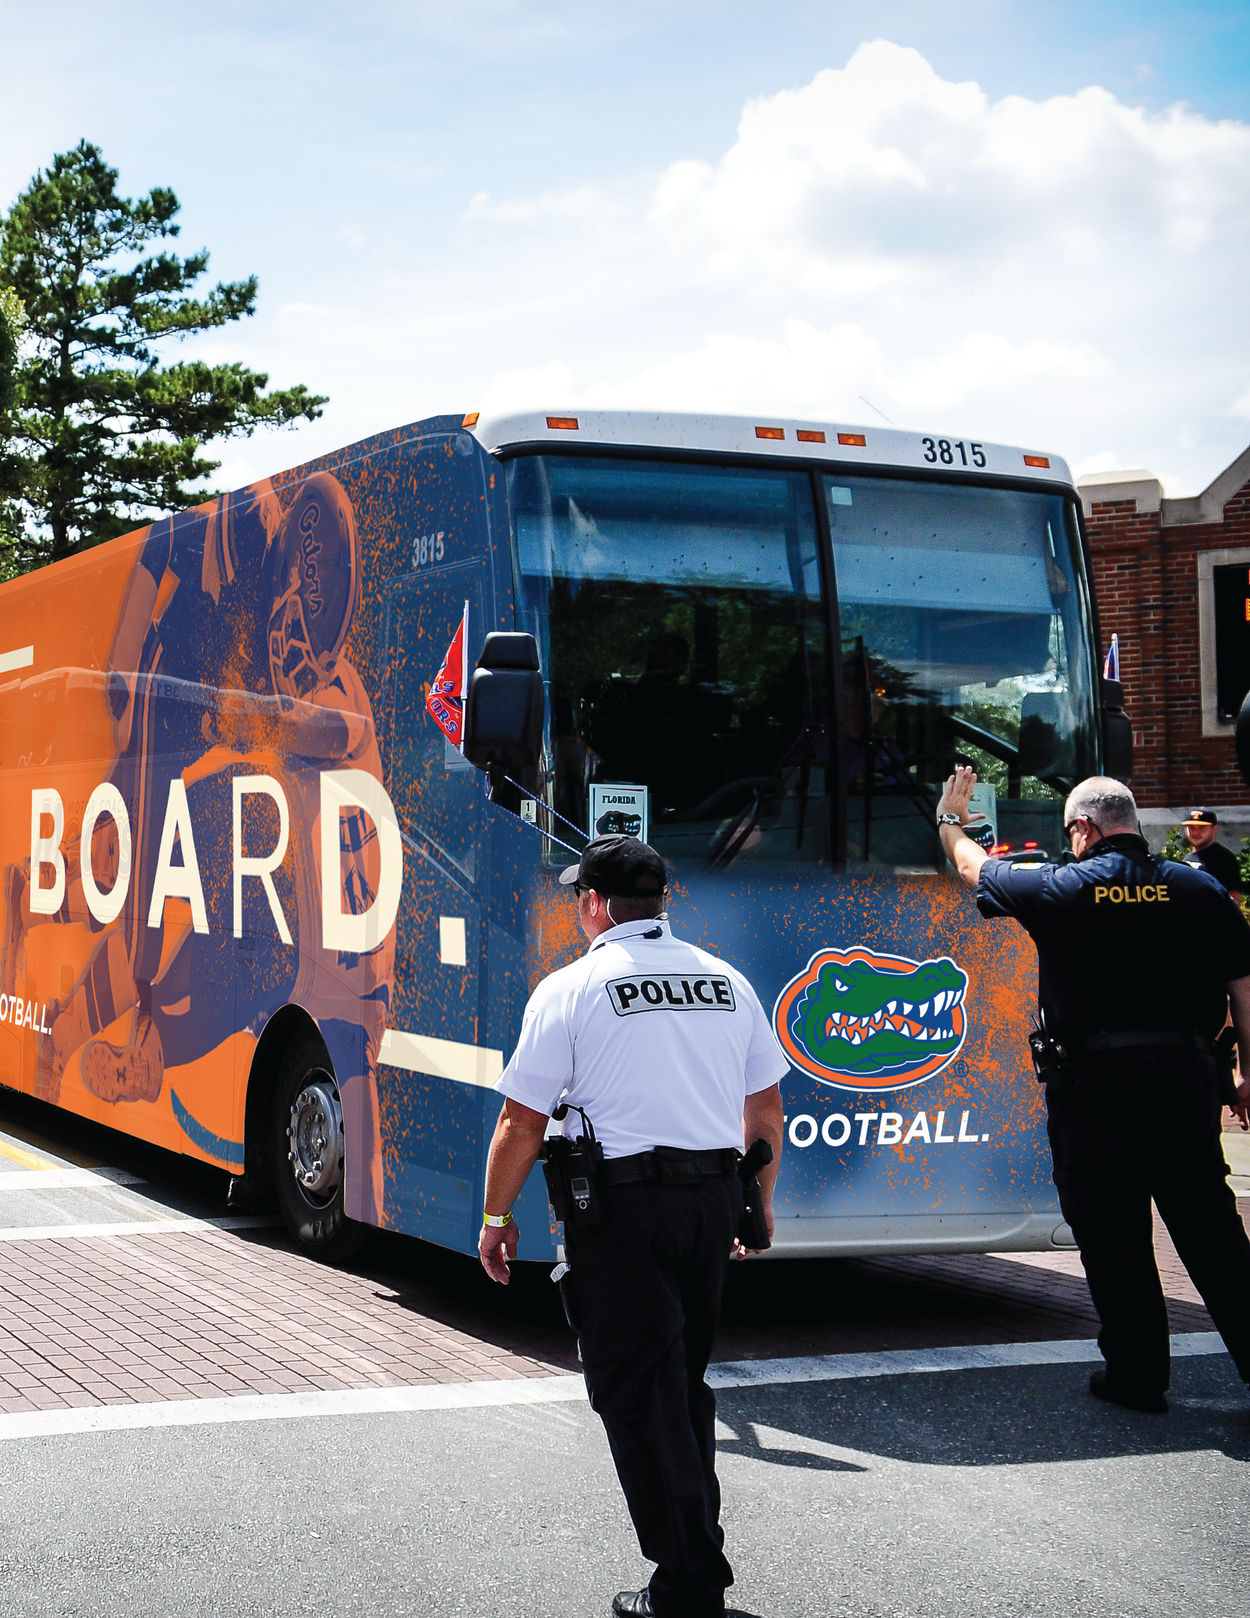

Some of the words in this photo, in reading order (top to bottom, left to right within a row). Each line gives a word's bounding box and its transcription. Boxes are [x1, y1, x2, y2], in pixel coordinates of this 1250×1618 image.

[921, 437, 987, 468] 3815
[299, 503, 323, 618] Gators
[412, 531, 444, 567] 3815
[602, 795, 636, 805] FLORIDA
[30, 769, 466, 967] BOARD.
[1095, 885, 1170, 903] POLICE
[614, 979, 732, 1010] POLICE
[784, 1110, 989, 1148] OOTBALL.
